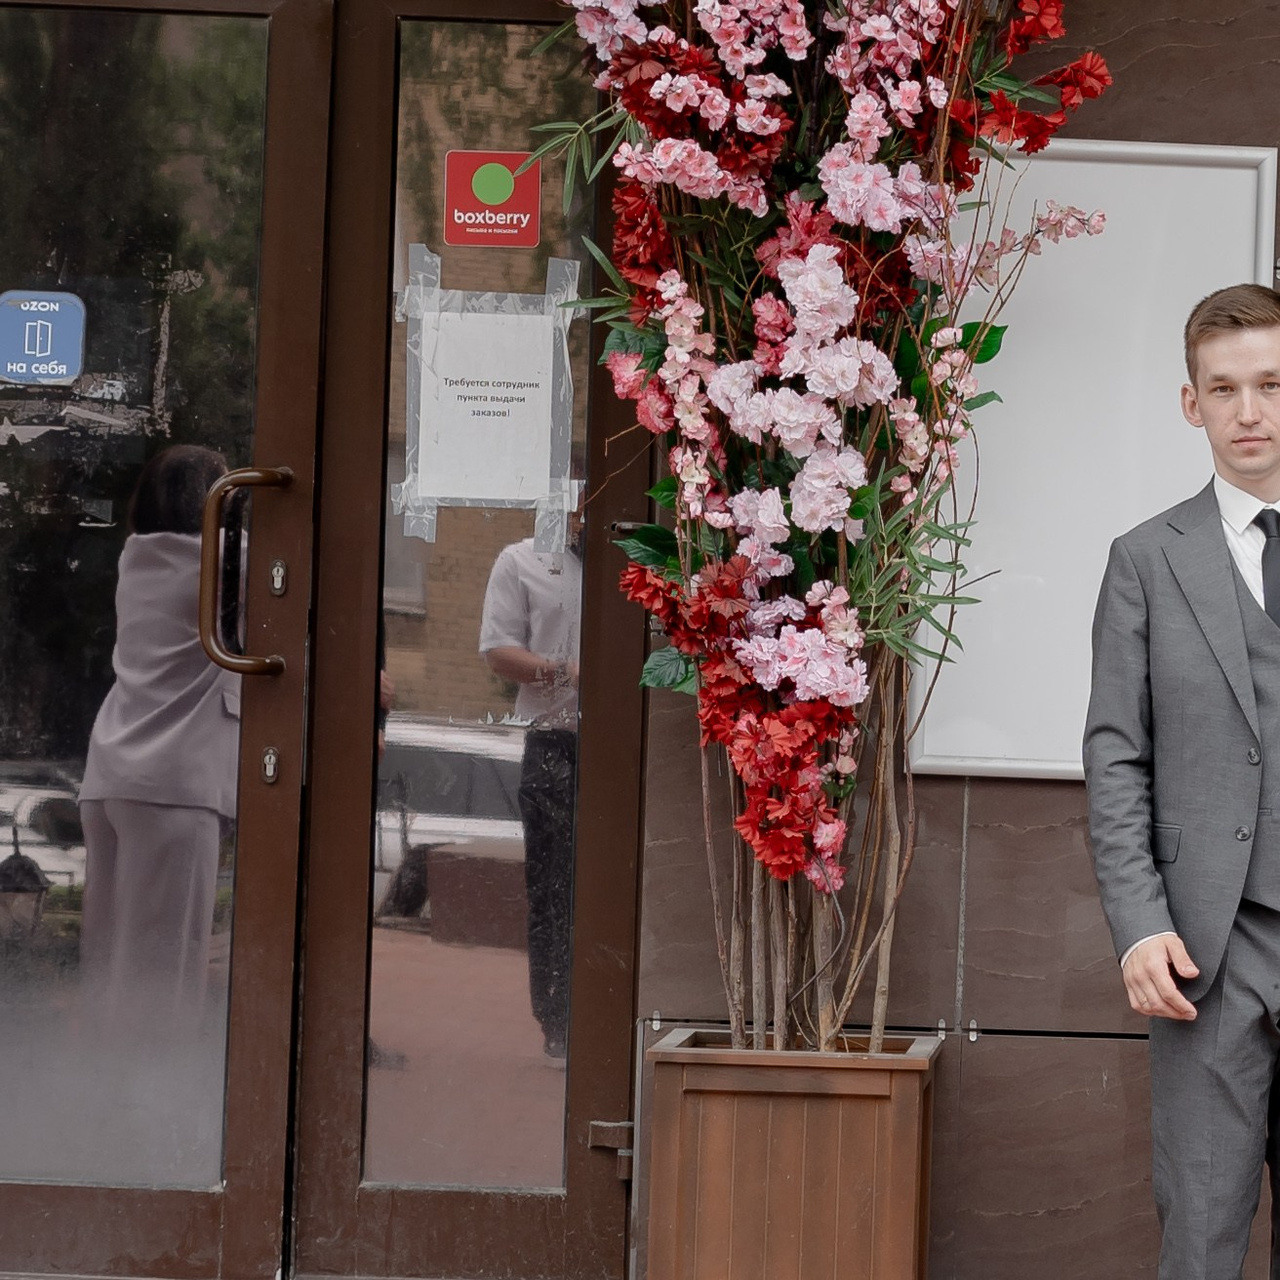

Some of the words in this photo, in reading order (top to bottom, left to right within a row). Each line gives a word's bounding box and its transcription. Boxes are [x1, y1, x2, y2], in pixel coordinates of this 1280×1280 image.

[453, 208, 531, 228] boxberry
[7, 362, 27, 373] на
[31, 360, 67, 375] себя
[443, 377, 490, 388] Требуется
[491, 380, 541, 390] сотрудник
[456, 394, 488, 403] пункта
[490, 395, 526, 404] выдачи
[470, 409, 511, 417] заказов!
